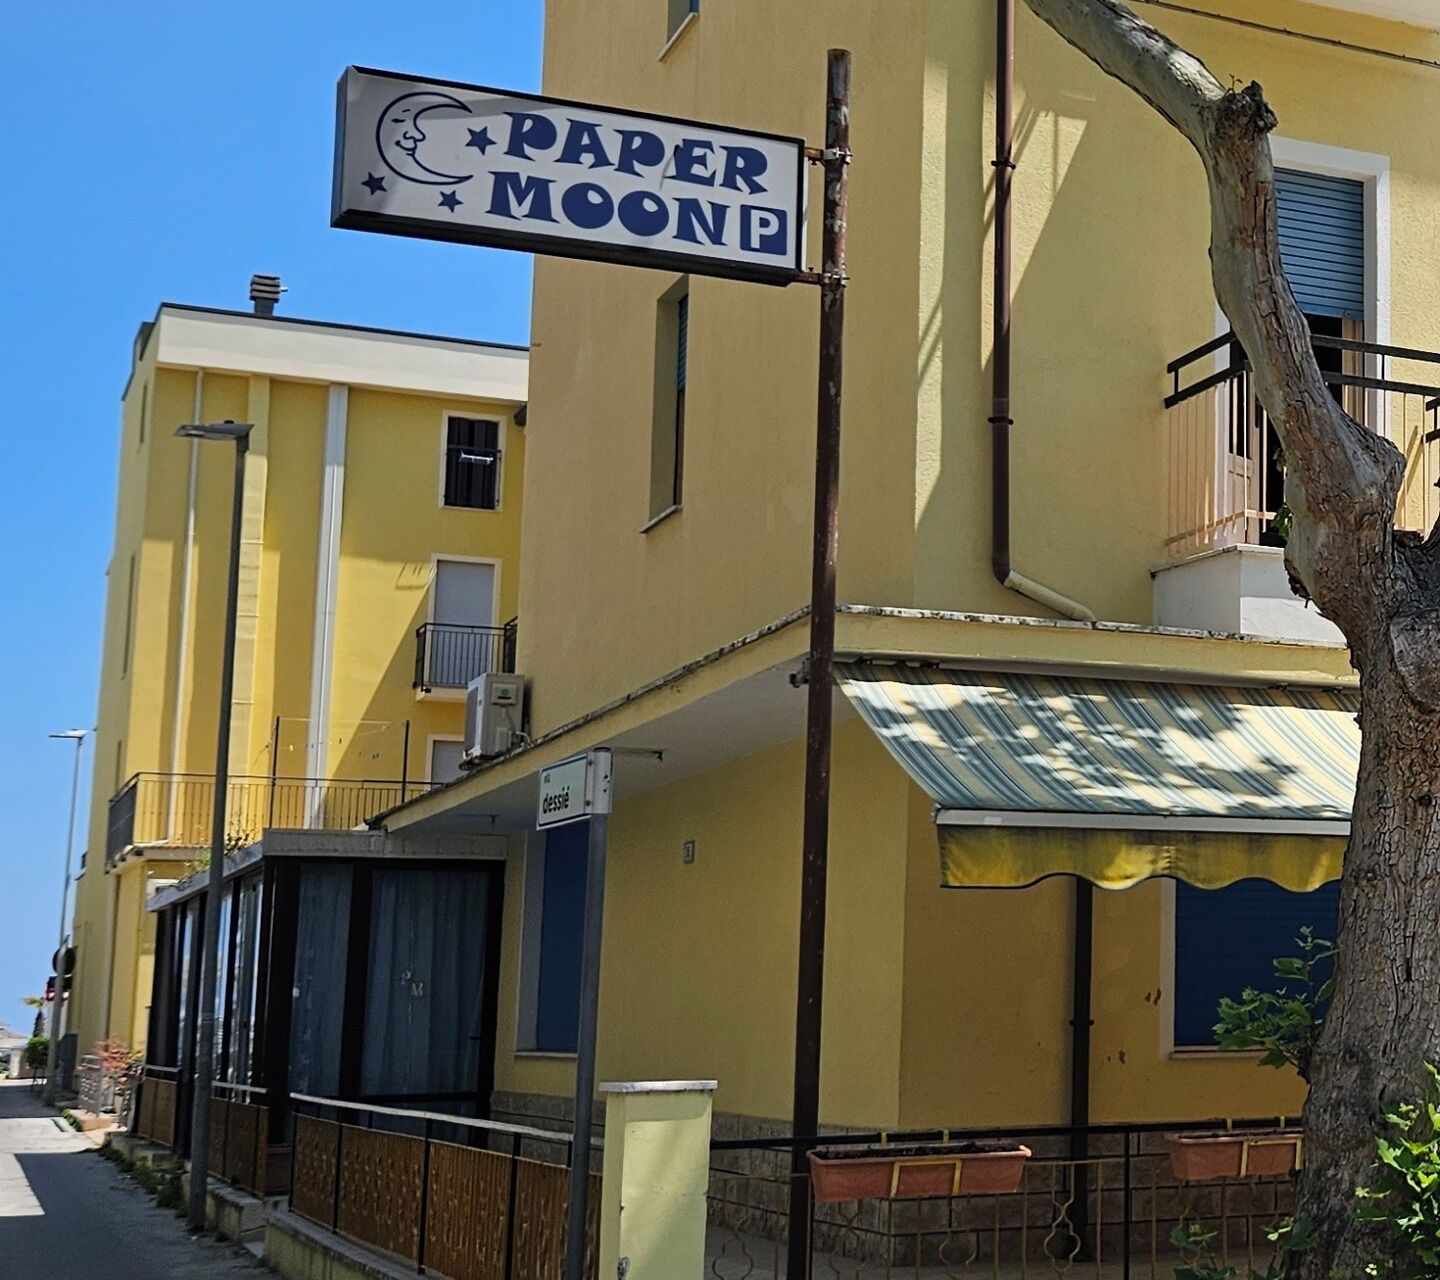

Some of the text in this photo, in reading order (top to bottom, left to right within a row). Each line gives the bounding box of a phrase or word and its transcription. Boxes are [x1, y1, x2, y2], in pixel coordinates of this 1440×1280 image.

[502, 110, 769, 196] PAPER
[485, 170, 732, 247] MOON
[748, 213, 781, 251] P
[542, 785, 570, 815] dessié
